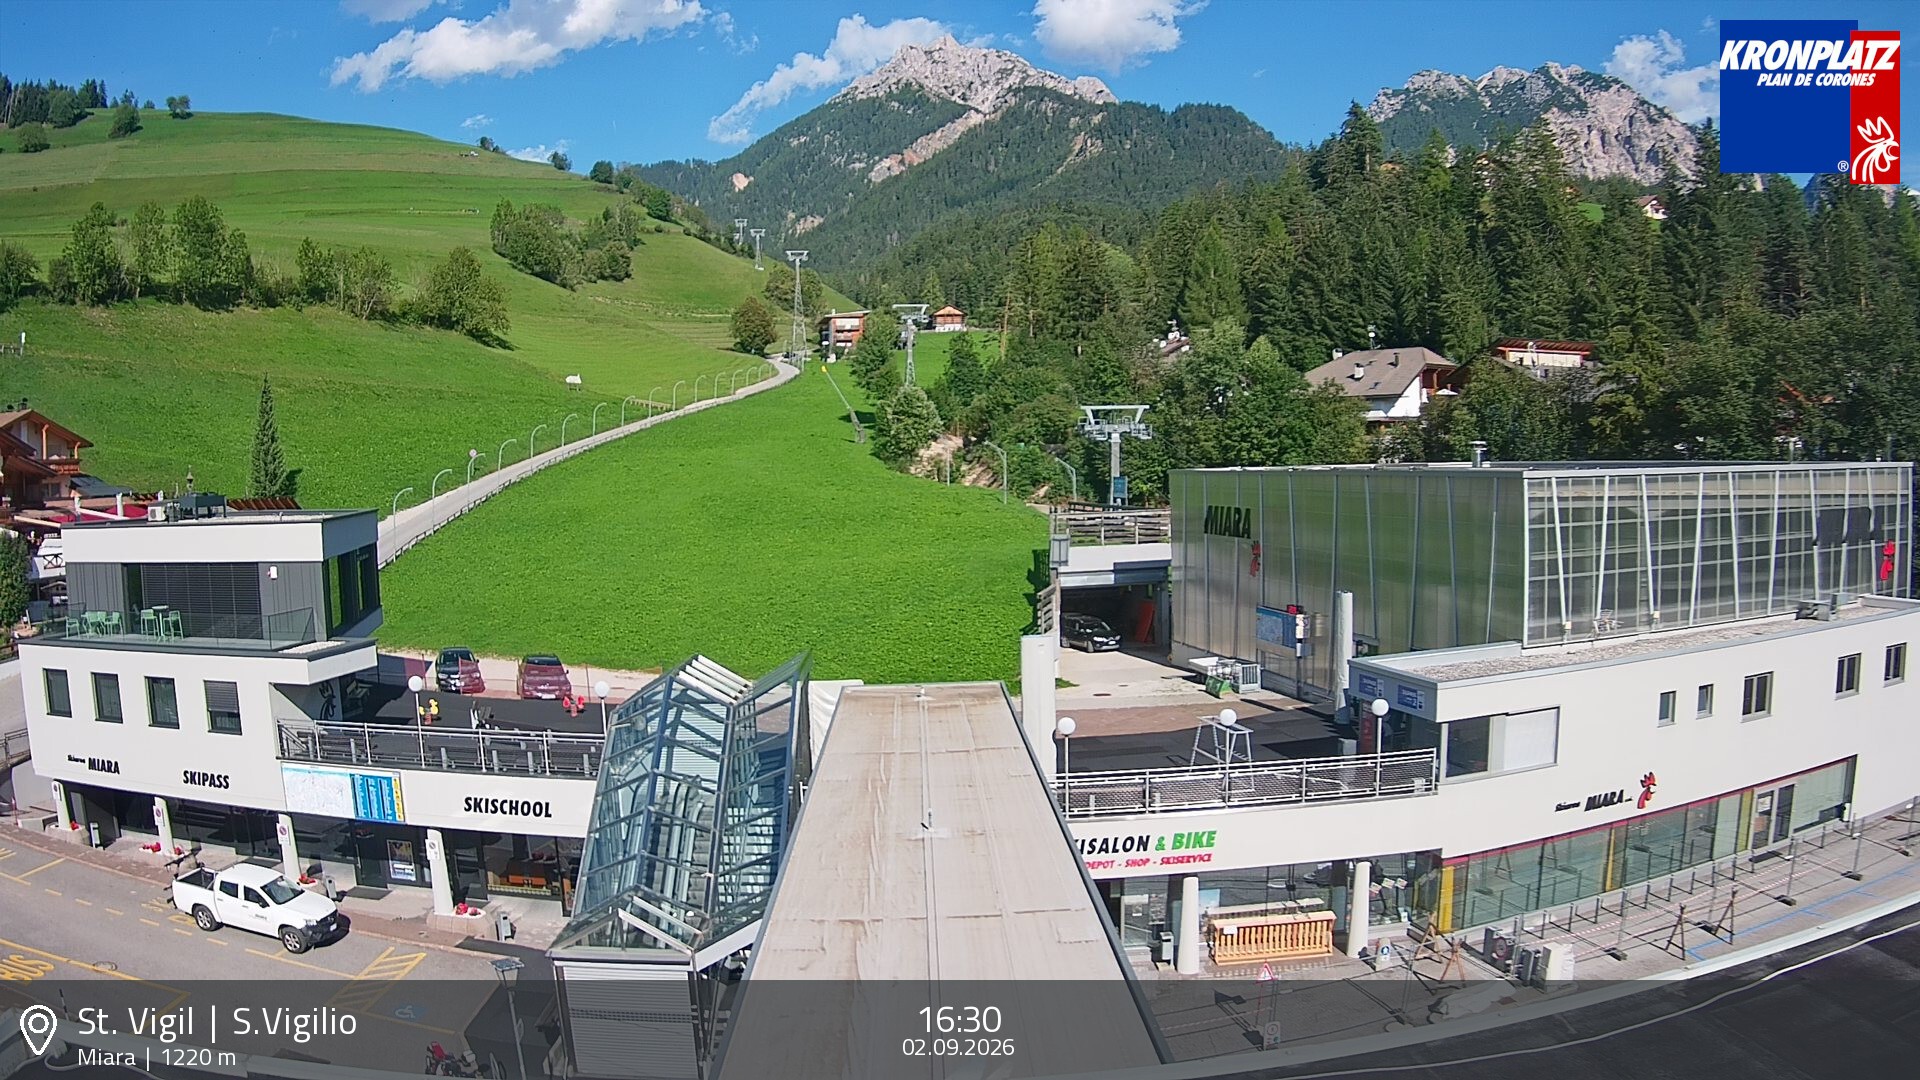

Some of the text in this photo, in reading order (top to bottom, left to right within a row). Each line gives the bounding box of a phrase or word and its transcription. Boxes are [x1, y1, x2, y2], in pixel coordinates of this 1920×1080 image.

[1204, 505, 1251, 539] MIARA
[88, 757, 120, 775] MIARA
[183, 770, 230, 789] SKIPASS
[464, 796, 552, 818] SKISCHOOL
[1074, 830, 1217, 855] ISALON & BIKE
[1124, 857, 1150, 868] SHOP
